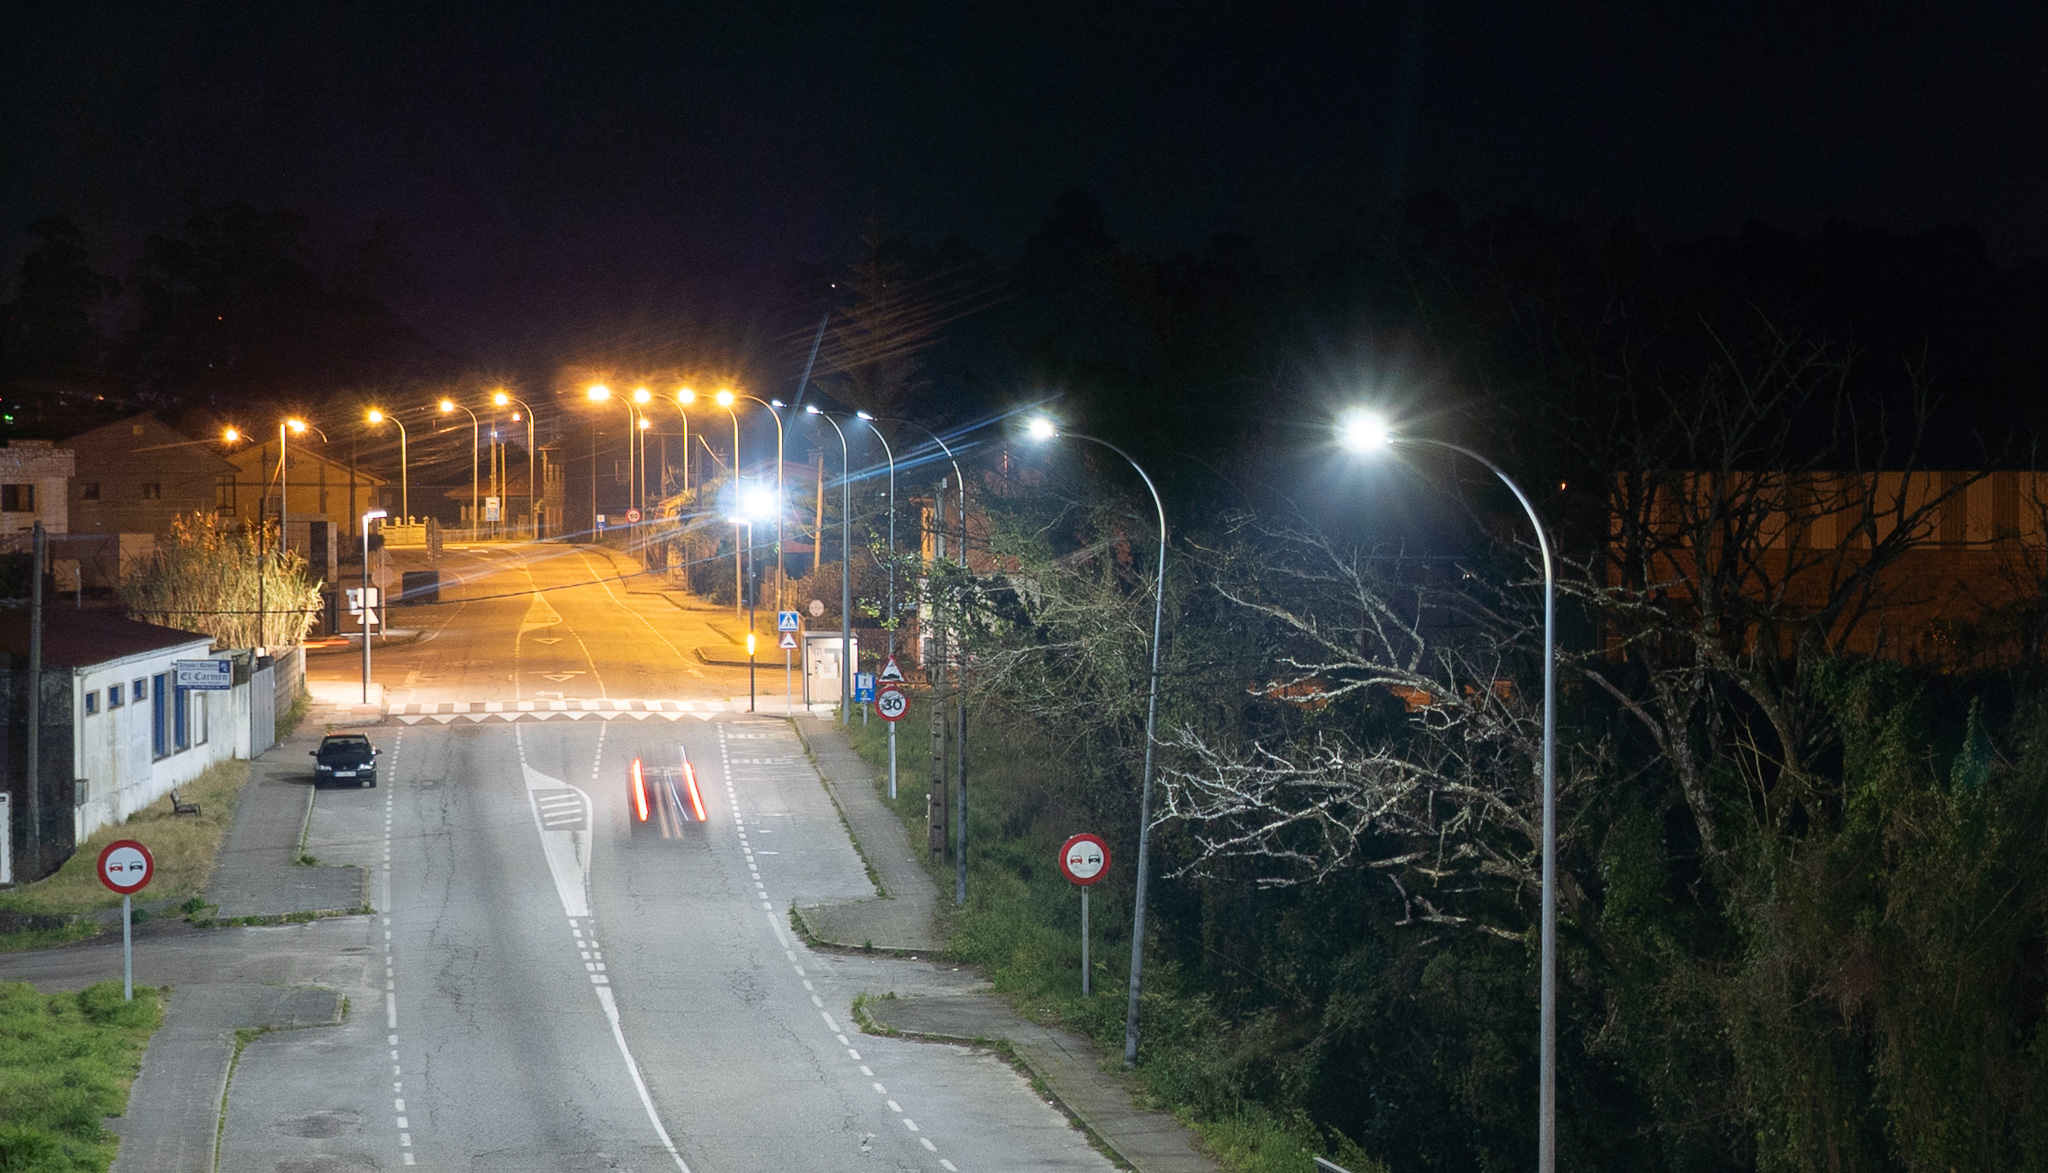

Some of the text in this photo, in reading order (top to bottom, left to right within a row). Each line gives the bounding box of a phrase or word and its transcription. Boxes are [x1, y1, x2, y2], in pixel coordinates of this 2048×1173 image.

[180, 672, 228, 681] El Carmen
[882, 698, 903, 711] 30
